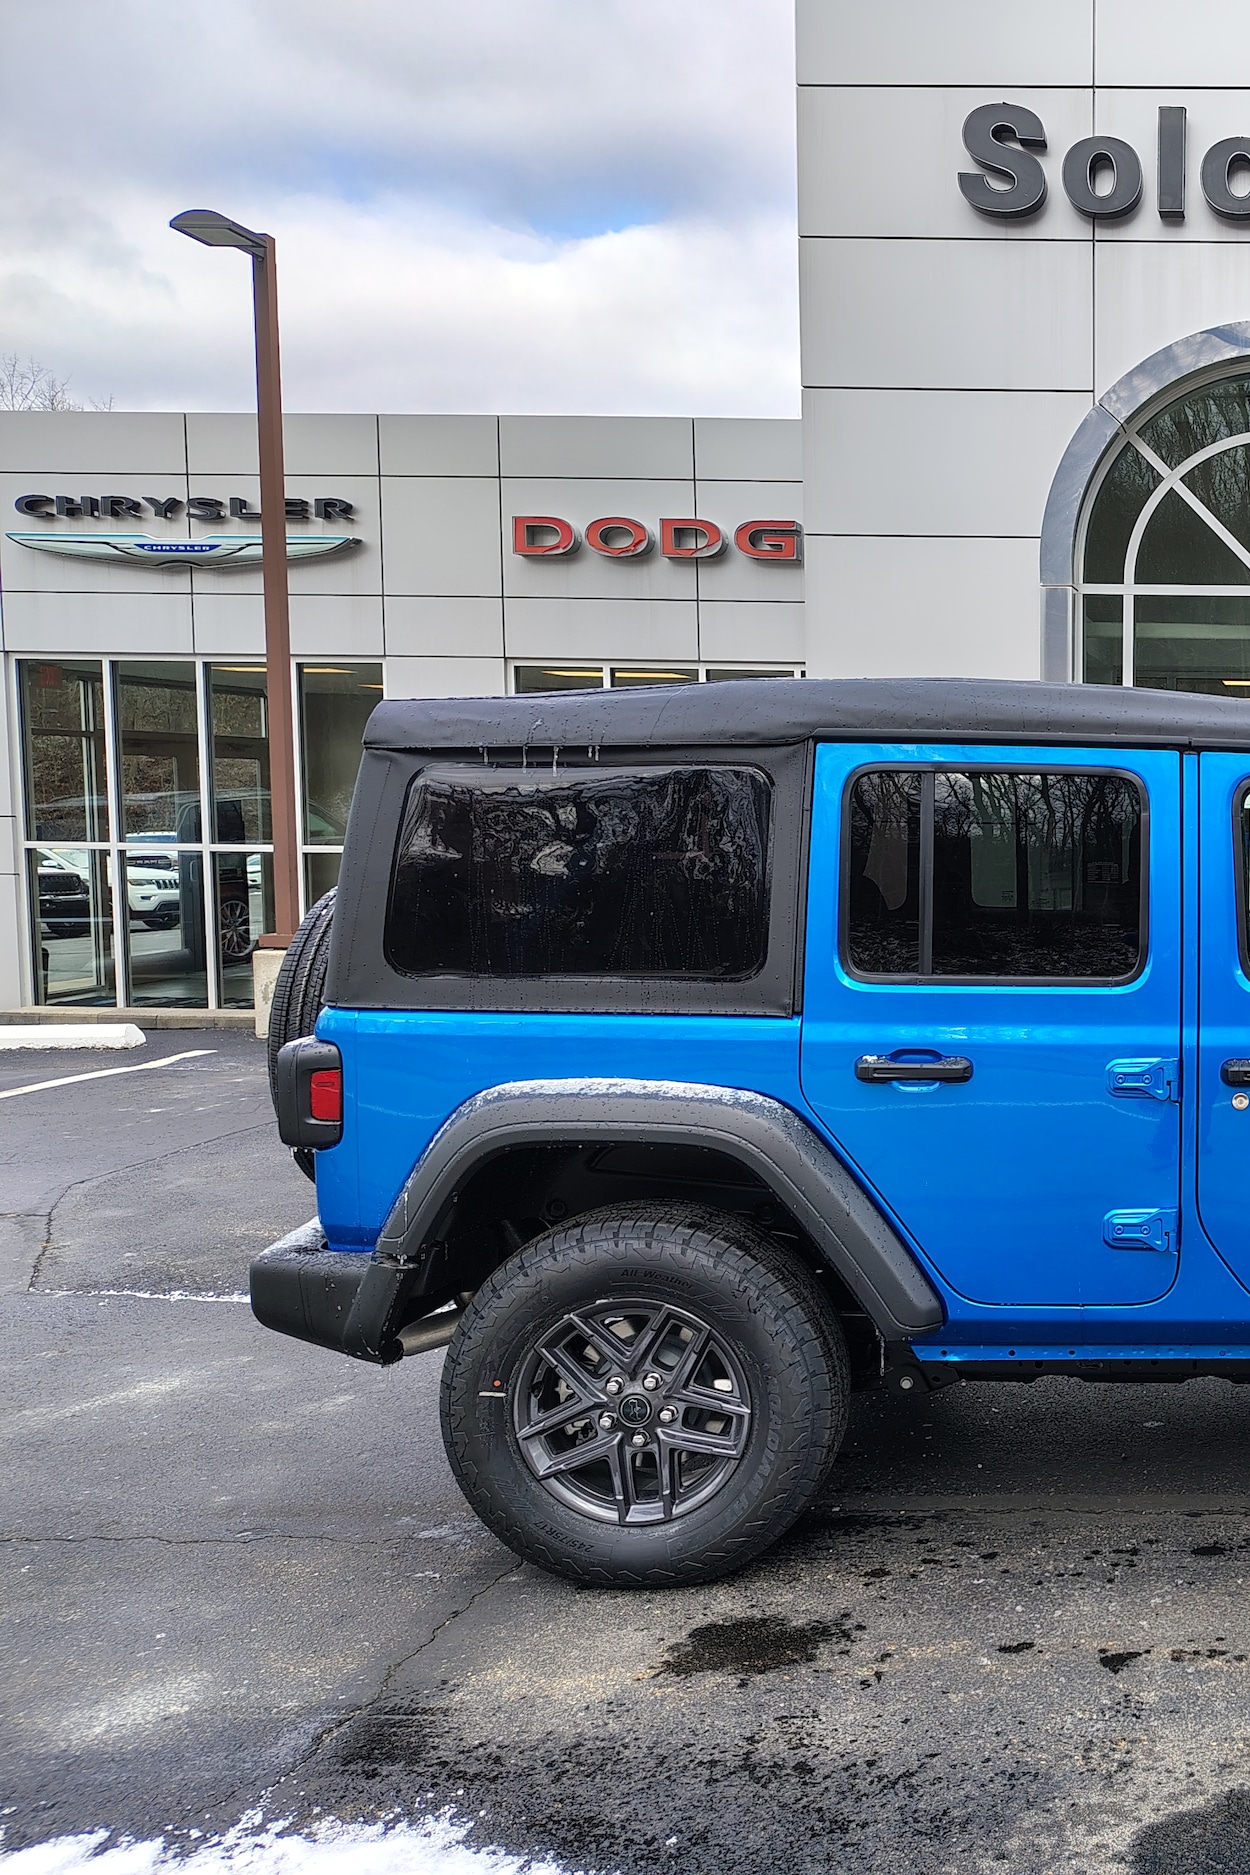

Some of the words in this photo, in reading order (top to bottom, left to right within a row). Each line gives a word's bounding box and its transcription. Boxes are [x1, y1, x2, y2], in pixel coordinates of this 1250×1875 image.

[14, 494, 355, 520] CHRYSLER
[512, 516, 804, 561] DODG
[532, 1518, 595, 1554] 245/75R17
